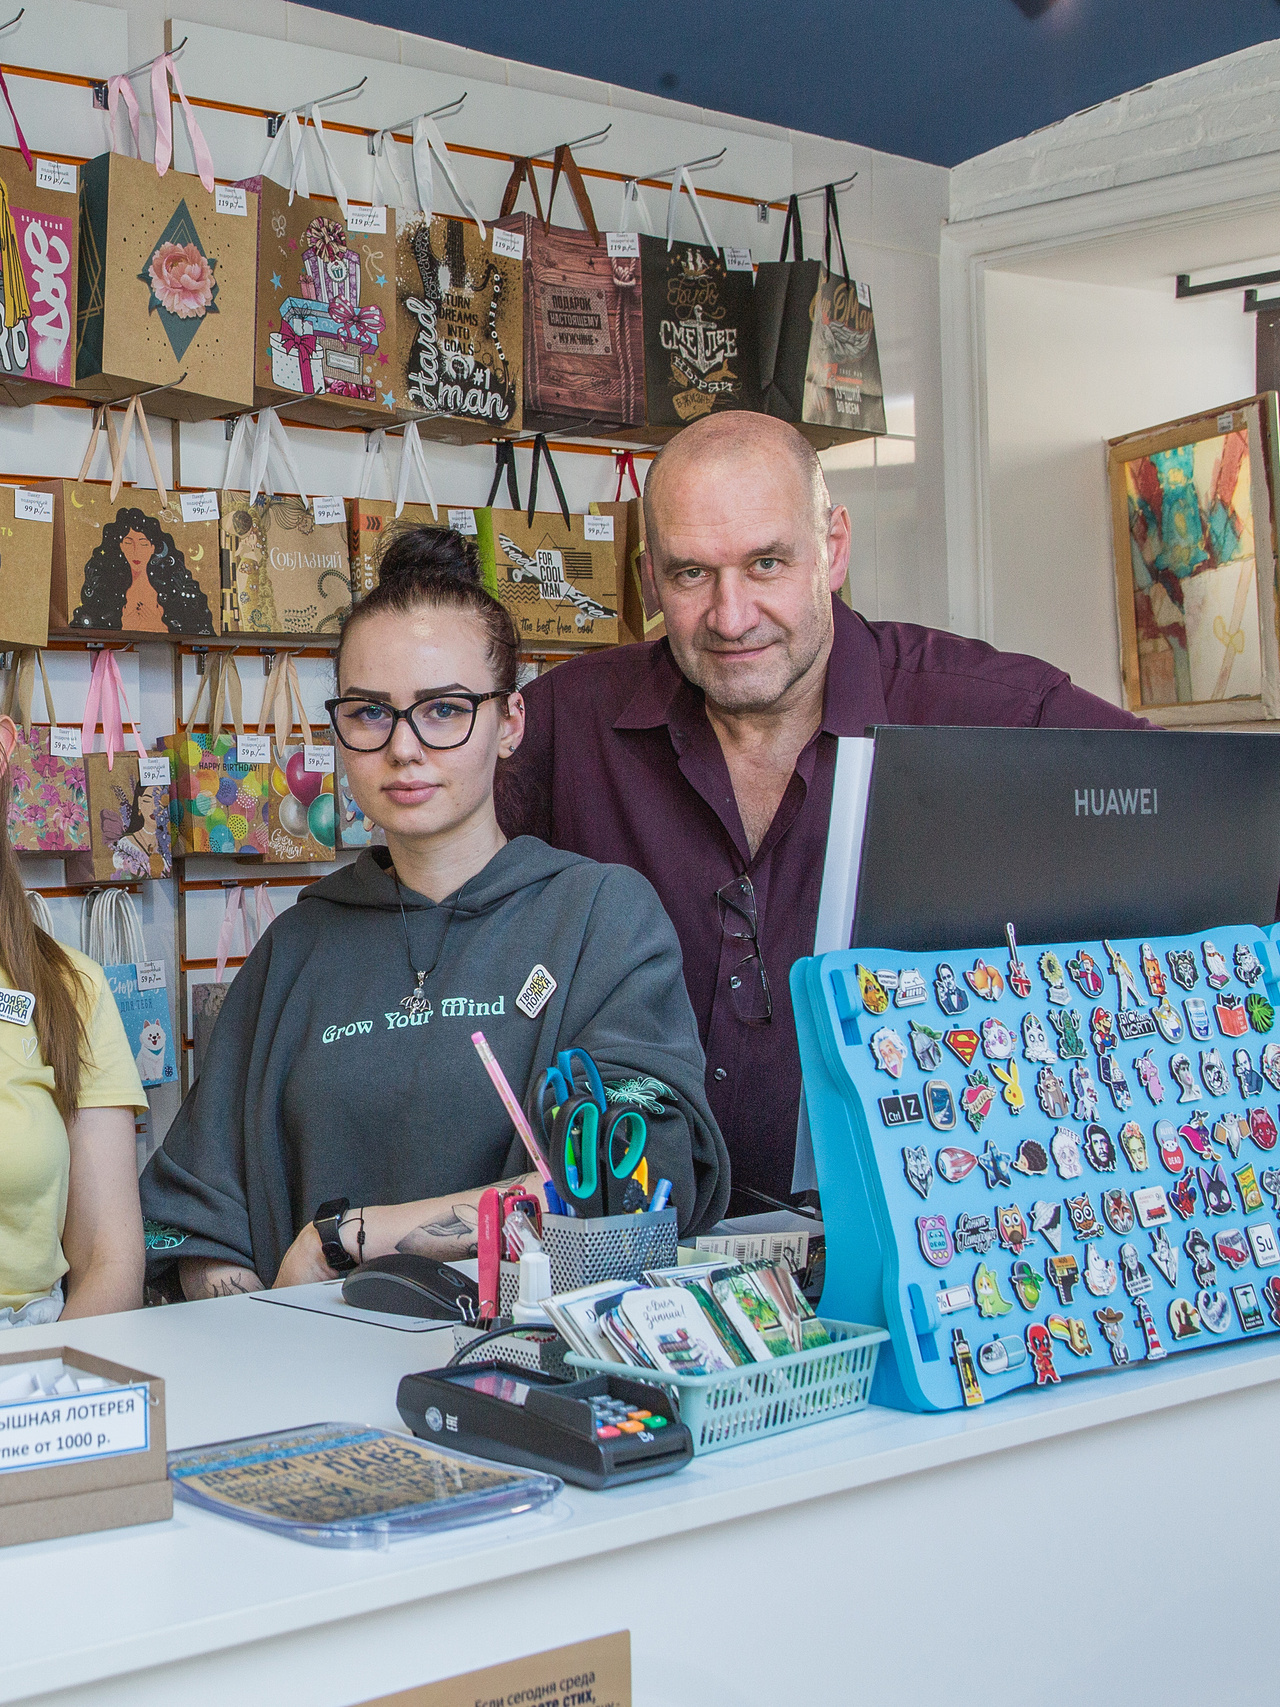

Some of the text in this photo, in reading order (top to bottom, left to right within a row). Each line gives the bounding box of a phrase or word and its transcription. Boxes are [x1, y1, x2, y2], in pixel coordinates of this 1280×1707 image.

[39, 173, 52, 182] 119
[350, 218, 363, 226] 119
[494, 241, 506, 249] 119
[444, 292, 471, 310] TURN
[551, 294, 591, 311] ПОДАРОК
[438, 308, 479, 327] DREAMS
[488, 273, 506, 361] GO BEYOND
[549, 312, 599, 328] НАСТОЯЩЕМУ
[447, 323, 470, 341] INTO
[558, 332, 593, 345] МУЖЧИНЕ
[659, 319, 738, 358] СМЕЛЕЕ
[406, 297, 439, 411] Hard
[444, 338, 474, 356] GOALS
[472, 367, 491, 390] #1
[673, 356, 733, 393] НЫРЯЙ
[438, 382, 509, 421] man
[318, 510, 326, 518] 99
[537, 551, 553, 566] FOR
[364, 554, 373, 591] GIFT
[539, 565, 564, 583] COOL
[541, 583, 561, 598] MAN
[143, 771, 151, 779] 59
[198, 762, 260, 772] HAPPY BIRTHDAY!
[1074, 788, 1158, 816] HUAWEI
[140, 975, 148, 983] 59
[519, 982, 537, 1005] ТВОЯ
[525, 978, 552, 1012] ПОЛКА
[120, 998, 152, 1013] ДЛЯ ТЕБЯ
[322, 1020, 373, 1044] Grow
[384, 1010, 434, 1030] Your
[441, 995, 506, 1017] Mind
[1119, 1010, 1138, 1025] RICK
[1121, 1020, 1154, 1037] MORTY
[888, 1099, 919, 1122] Ctrl Z
[1167, 1156, 1182, 1165] DEAD
[929, 1240, 946, 1248] DEAD
[1256, 1235, 1273, 1252] Su
[66, 1398, 136, 1424] ЛОТЕРЕЯ
[34, 1441, 51, 1454] от
[57, 1432, 93, 1450] 1000
[97, 1433, 111, 1449] р.
[506, 1682, 557, 1706] сегодня
[559, 1671, 596, 1692] среда
[563, 1690, 597, 1707] стих,
